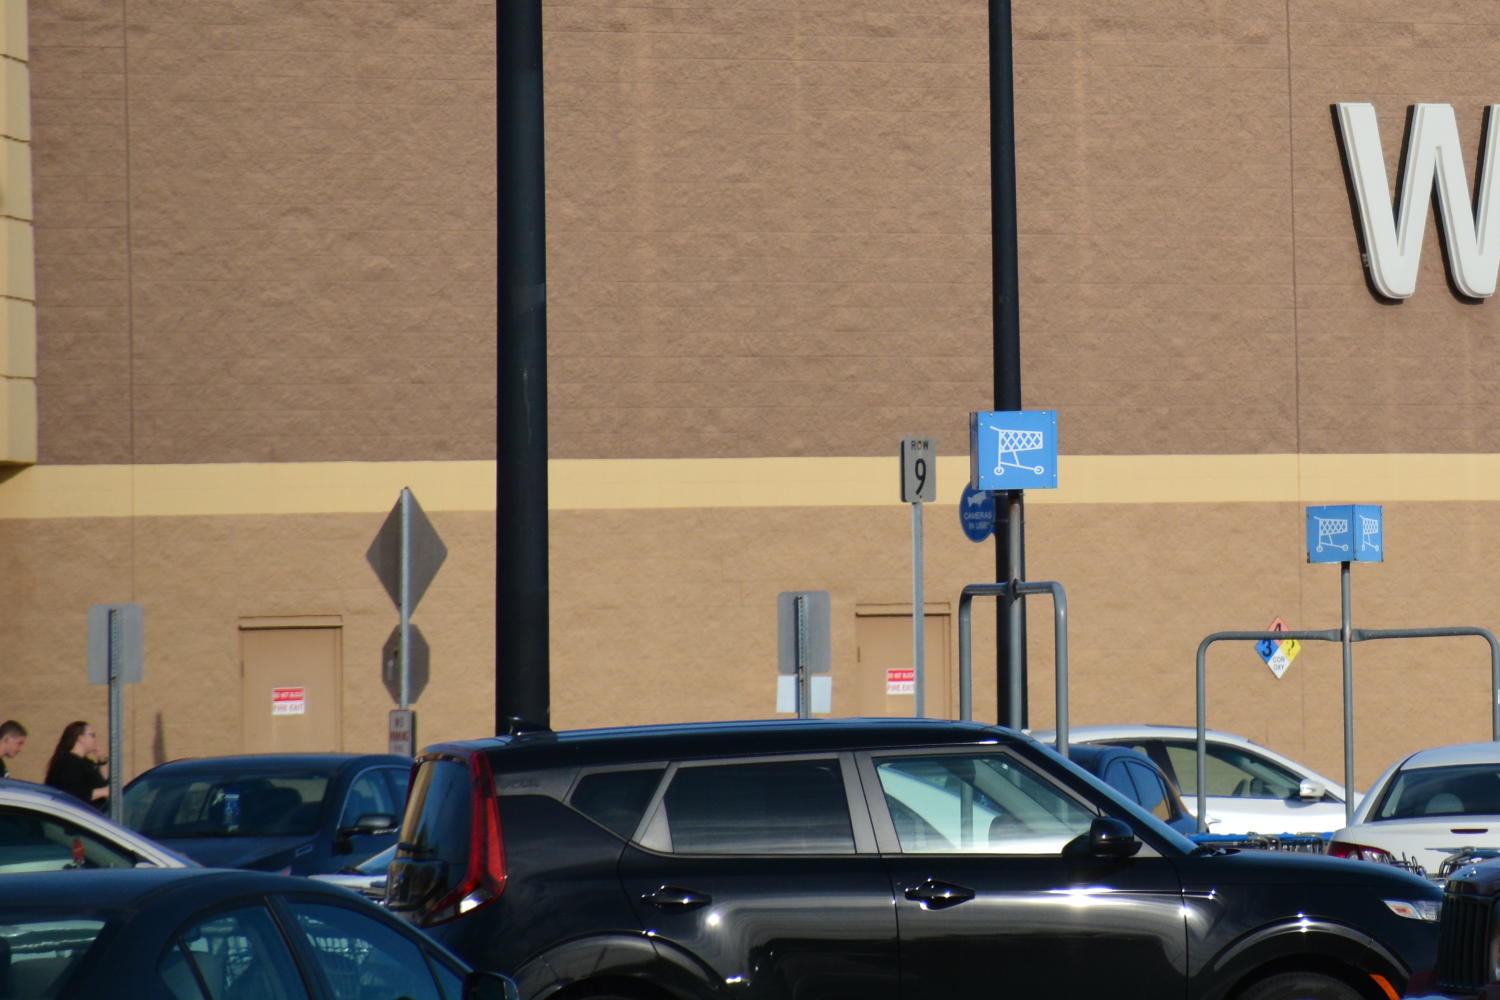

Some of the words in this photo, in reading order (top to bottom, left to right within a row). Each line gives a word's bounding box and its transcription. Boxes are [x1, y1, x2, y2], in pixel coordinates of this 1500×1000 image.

[911, 440, 929, 450] ROW
[915, 458, 927, 495] 9
[963, 511, 993, 520] CAMERAS
[1262, 638, 1273, 657] 3
